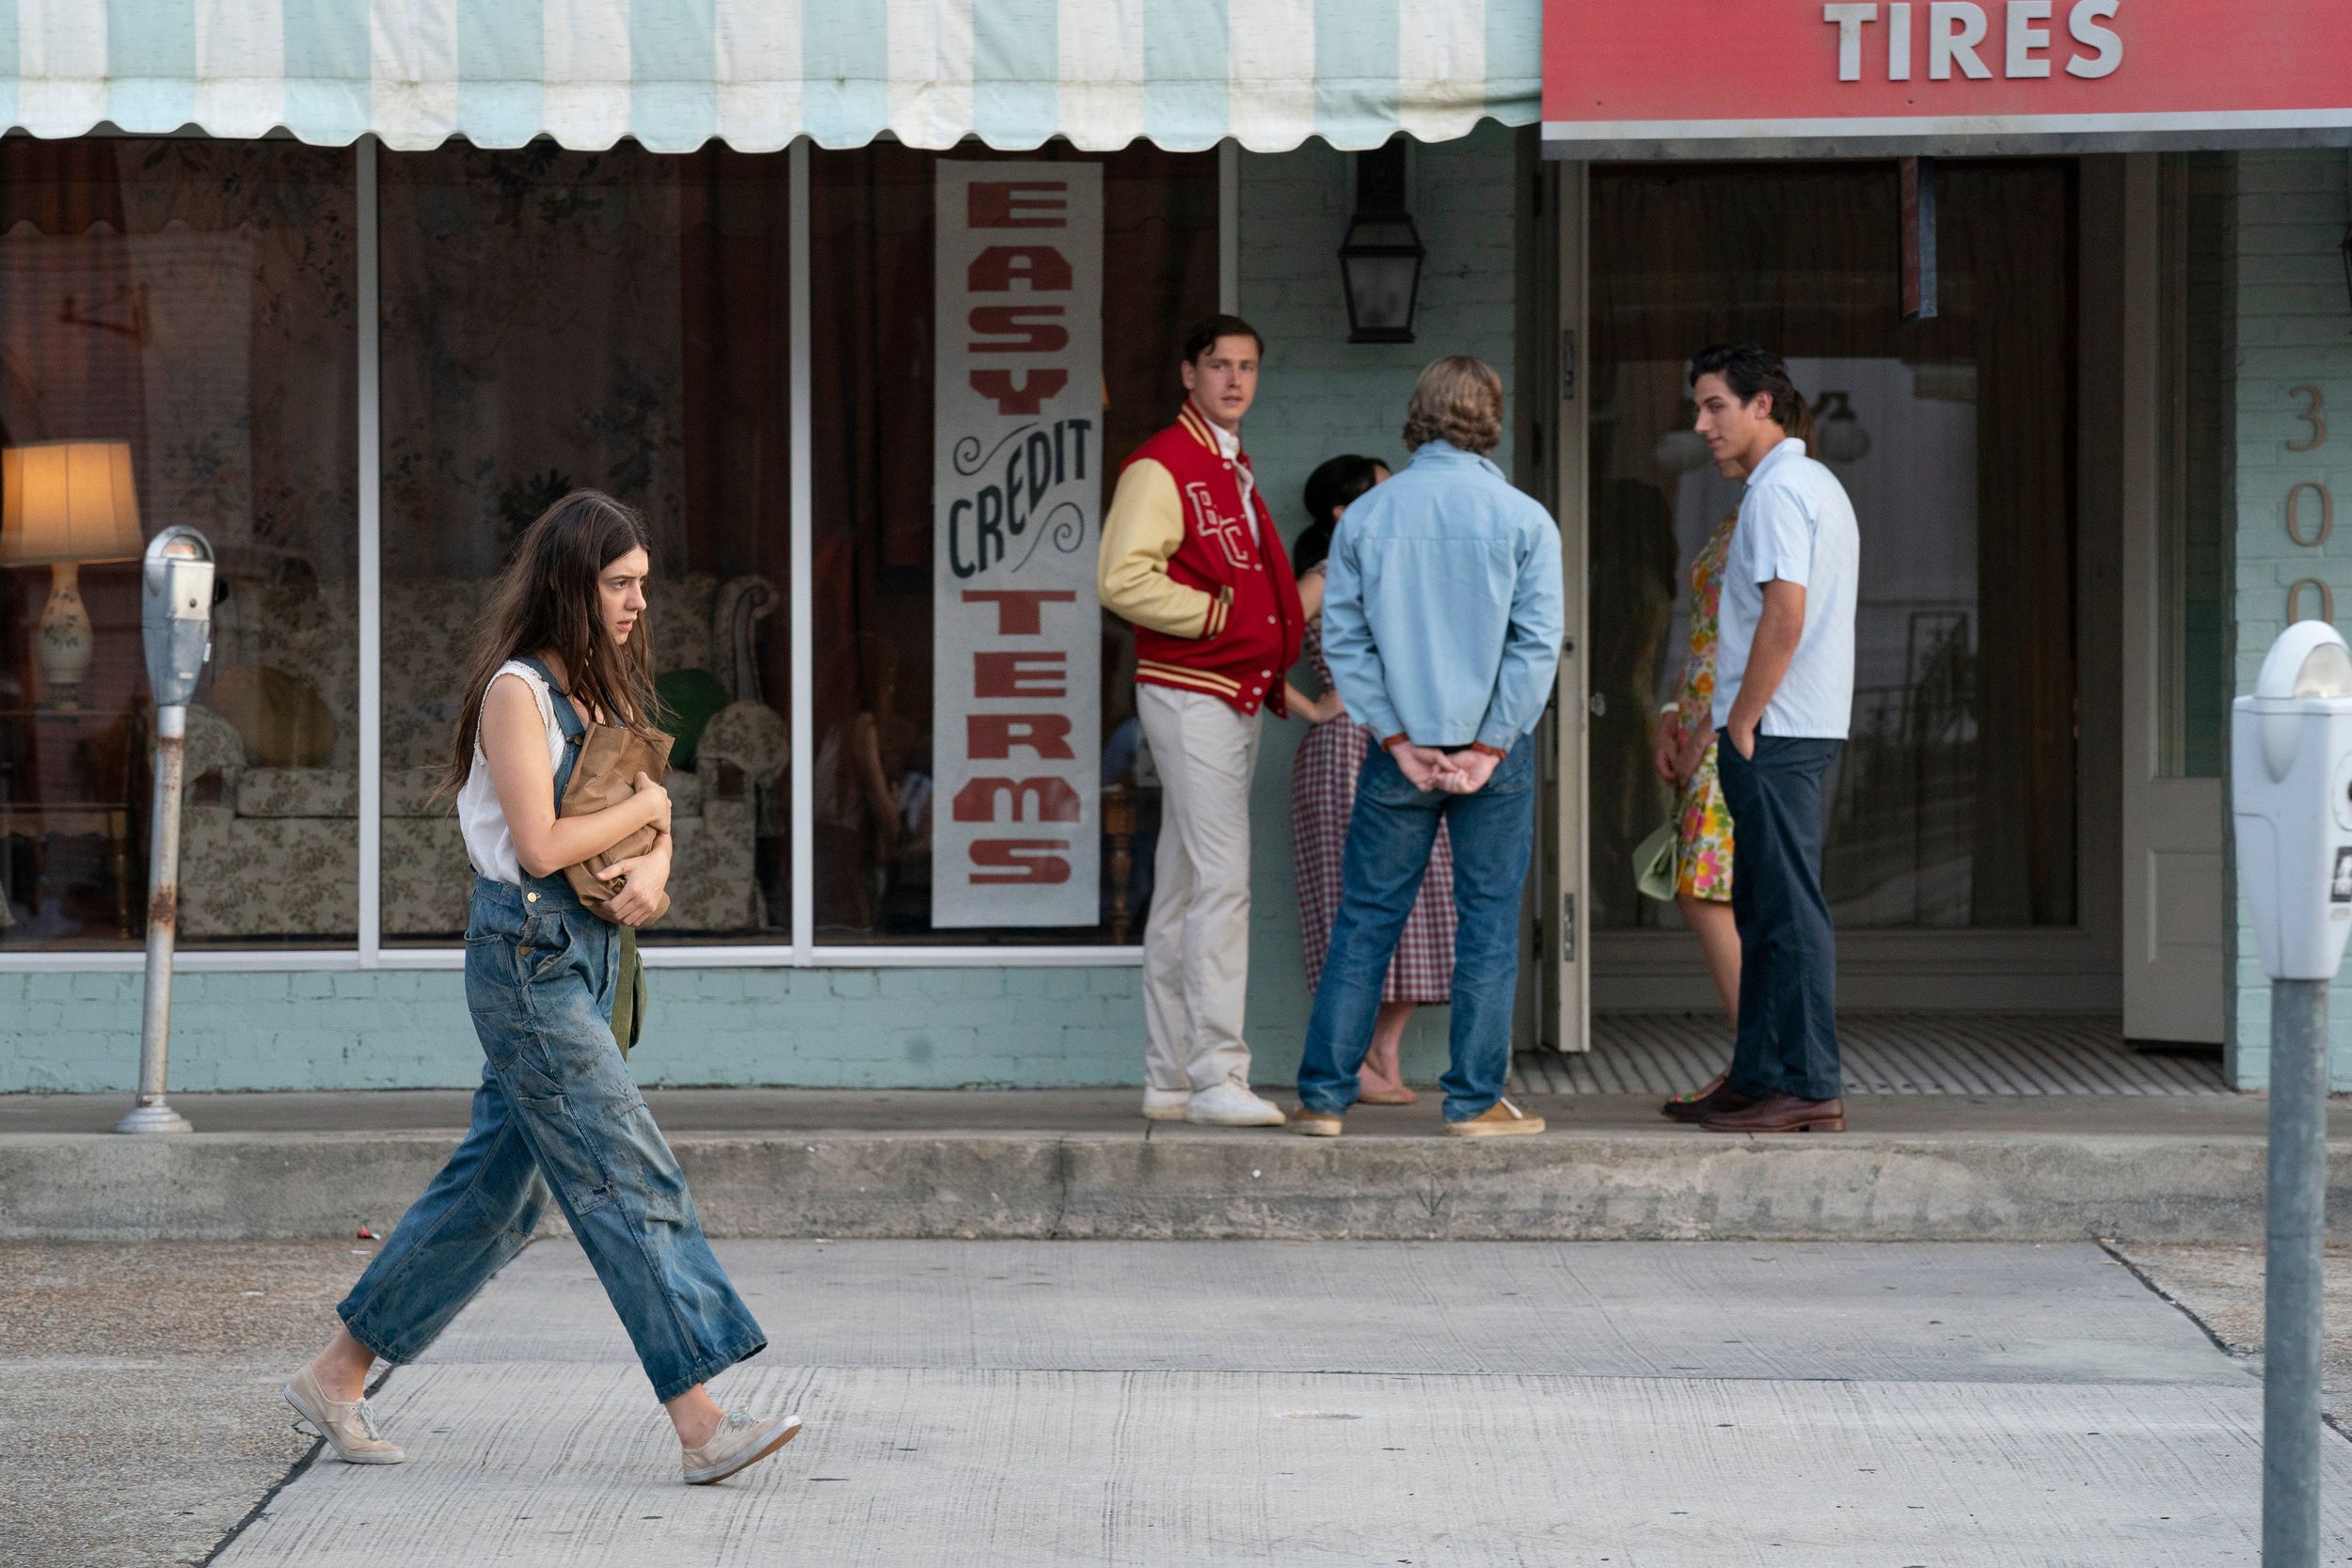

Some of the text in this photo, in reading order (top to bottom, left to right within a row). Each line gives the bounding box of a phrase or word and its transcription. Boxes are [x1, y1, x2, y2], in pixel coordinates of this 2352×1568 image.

[1823, 0, 2123, 81] TIRES
[967, 181, 1073, 416] EASY
[949, 419, 1092, 578] CREDIT
[952, 590, 1081, 884] TERMS
